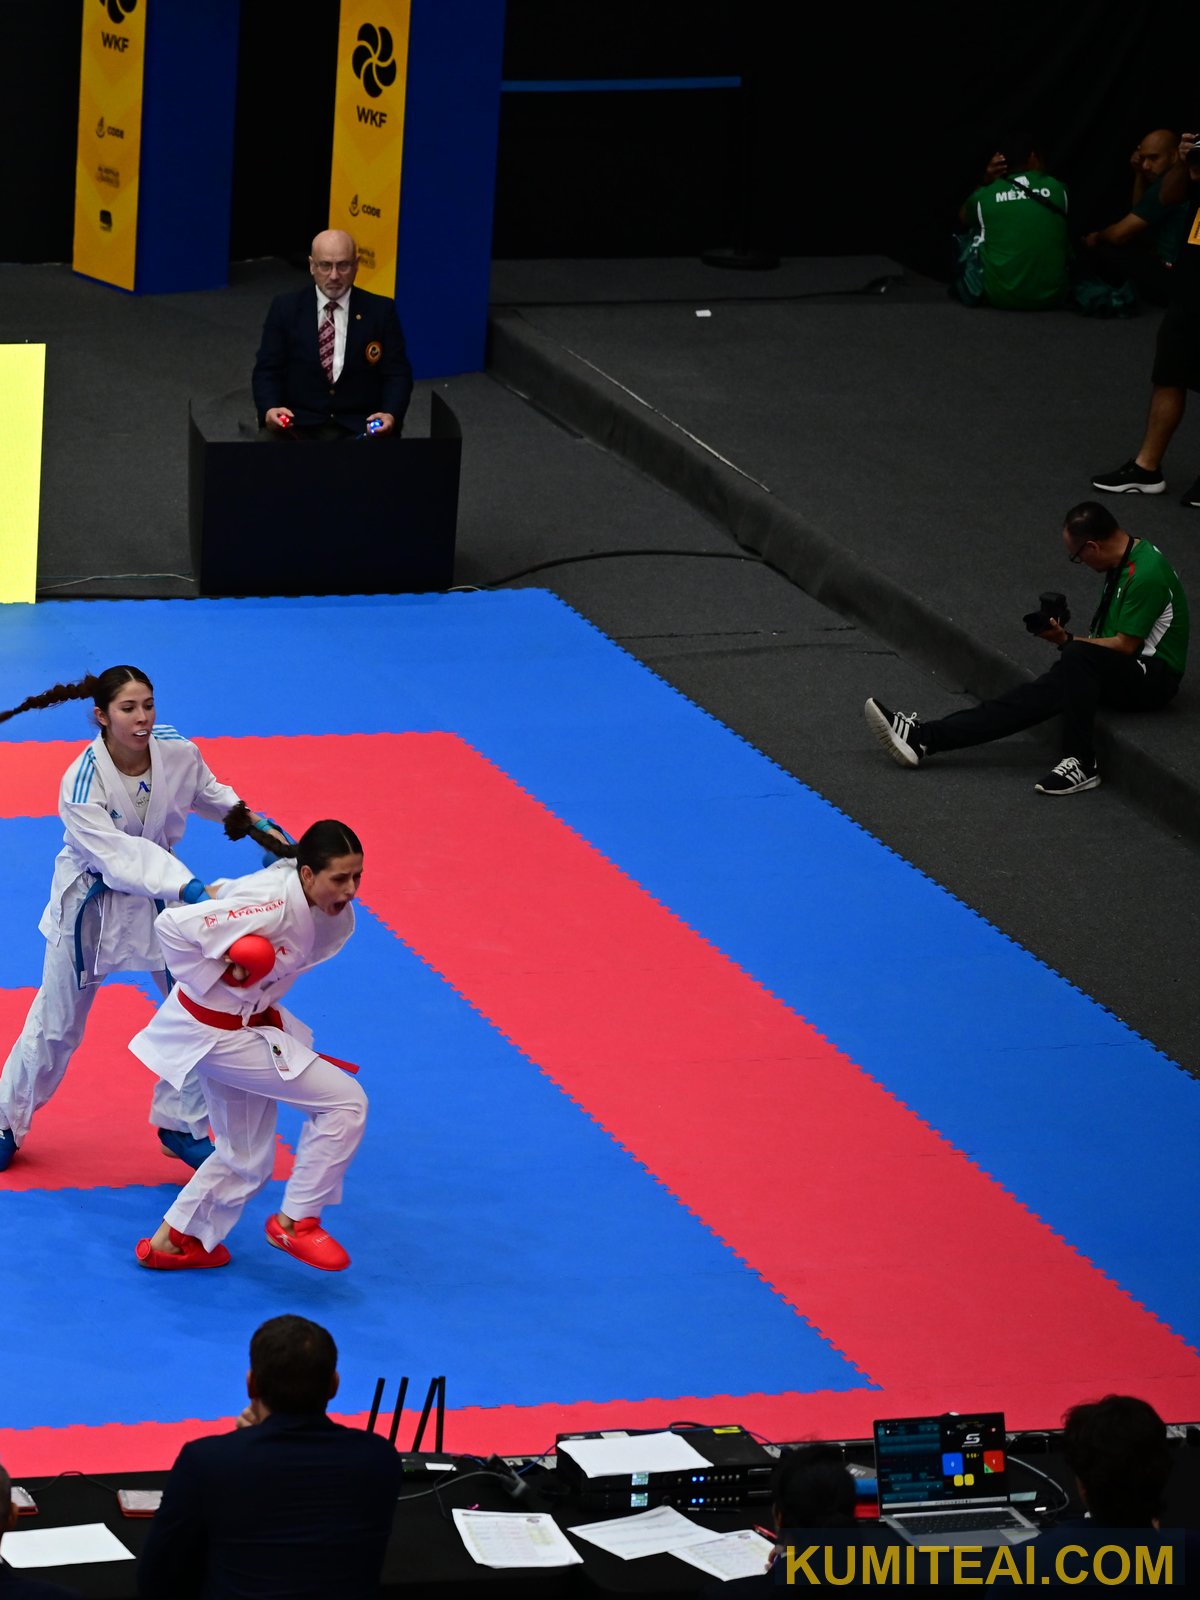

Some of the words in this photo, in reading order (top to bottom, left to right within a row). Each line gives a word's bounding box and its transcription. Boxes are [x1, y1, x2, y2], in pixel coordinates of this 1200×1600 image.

[101, 31, 129, 53] WKF
[356, 105, 387, 128] WKF
[362, 204, 381, 218] CODE
